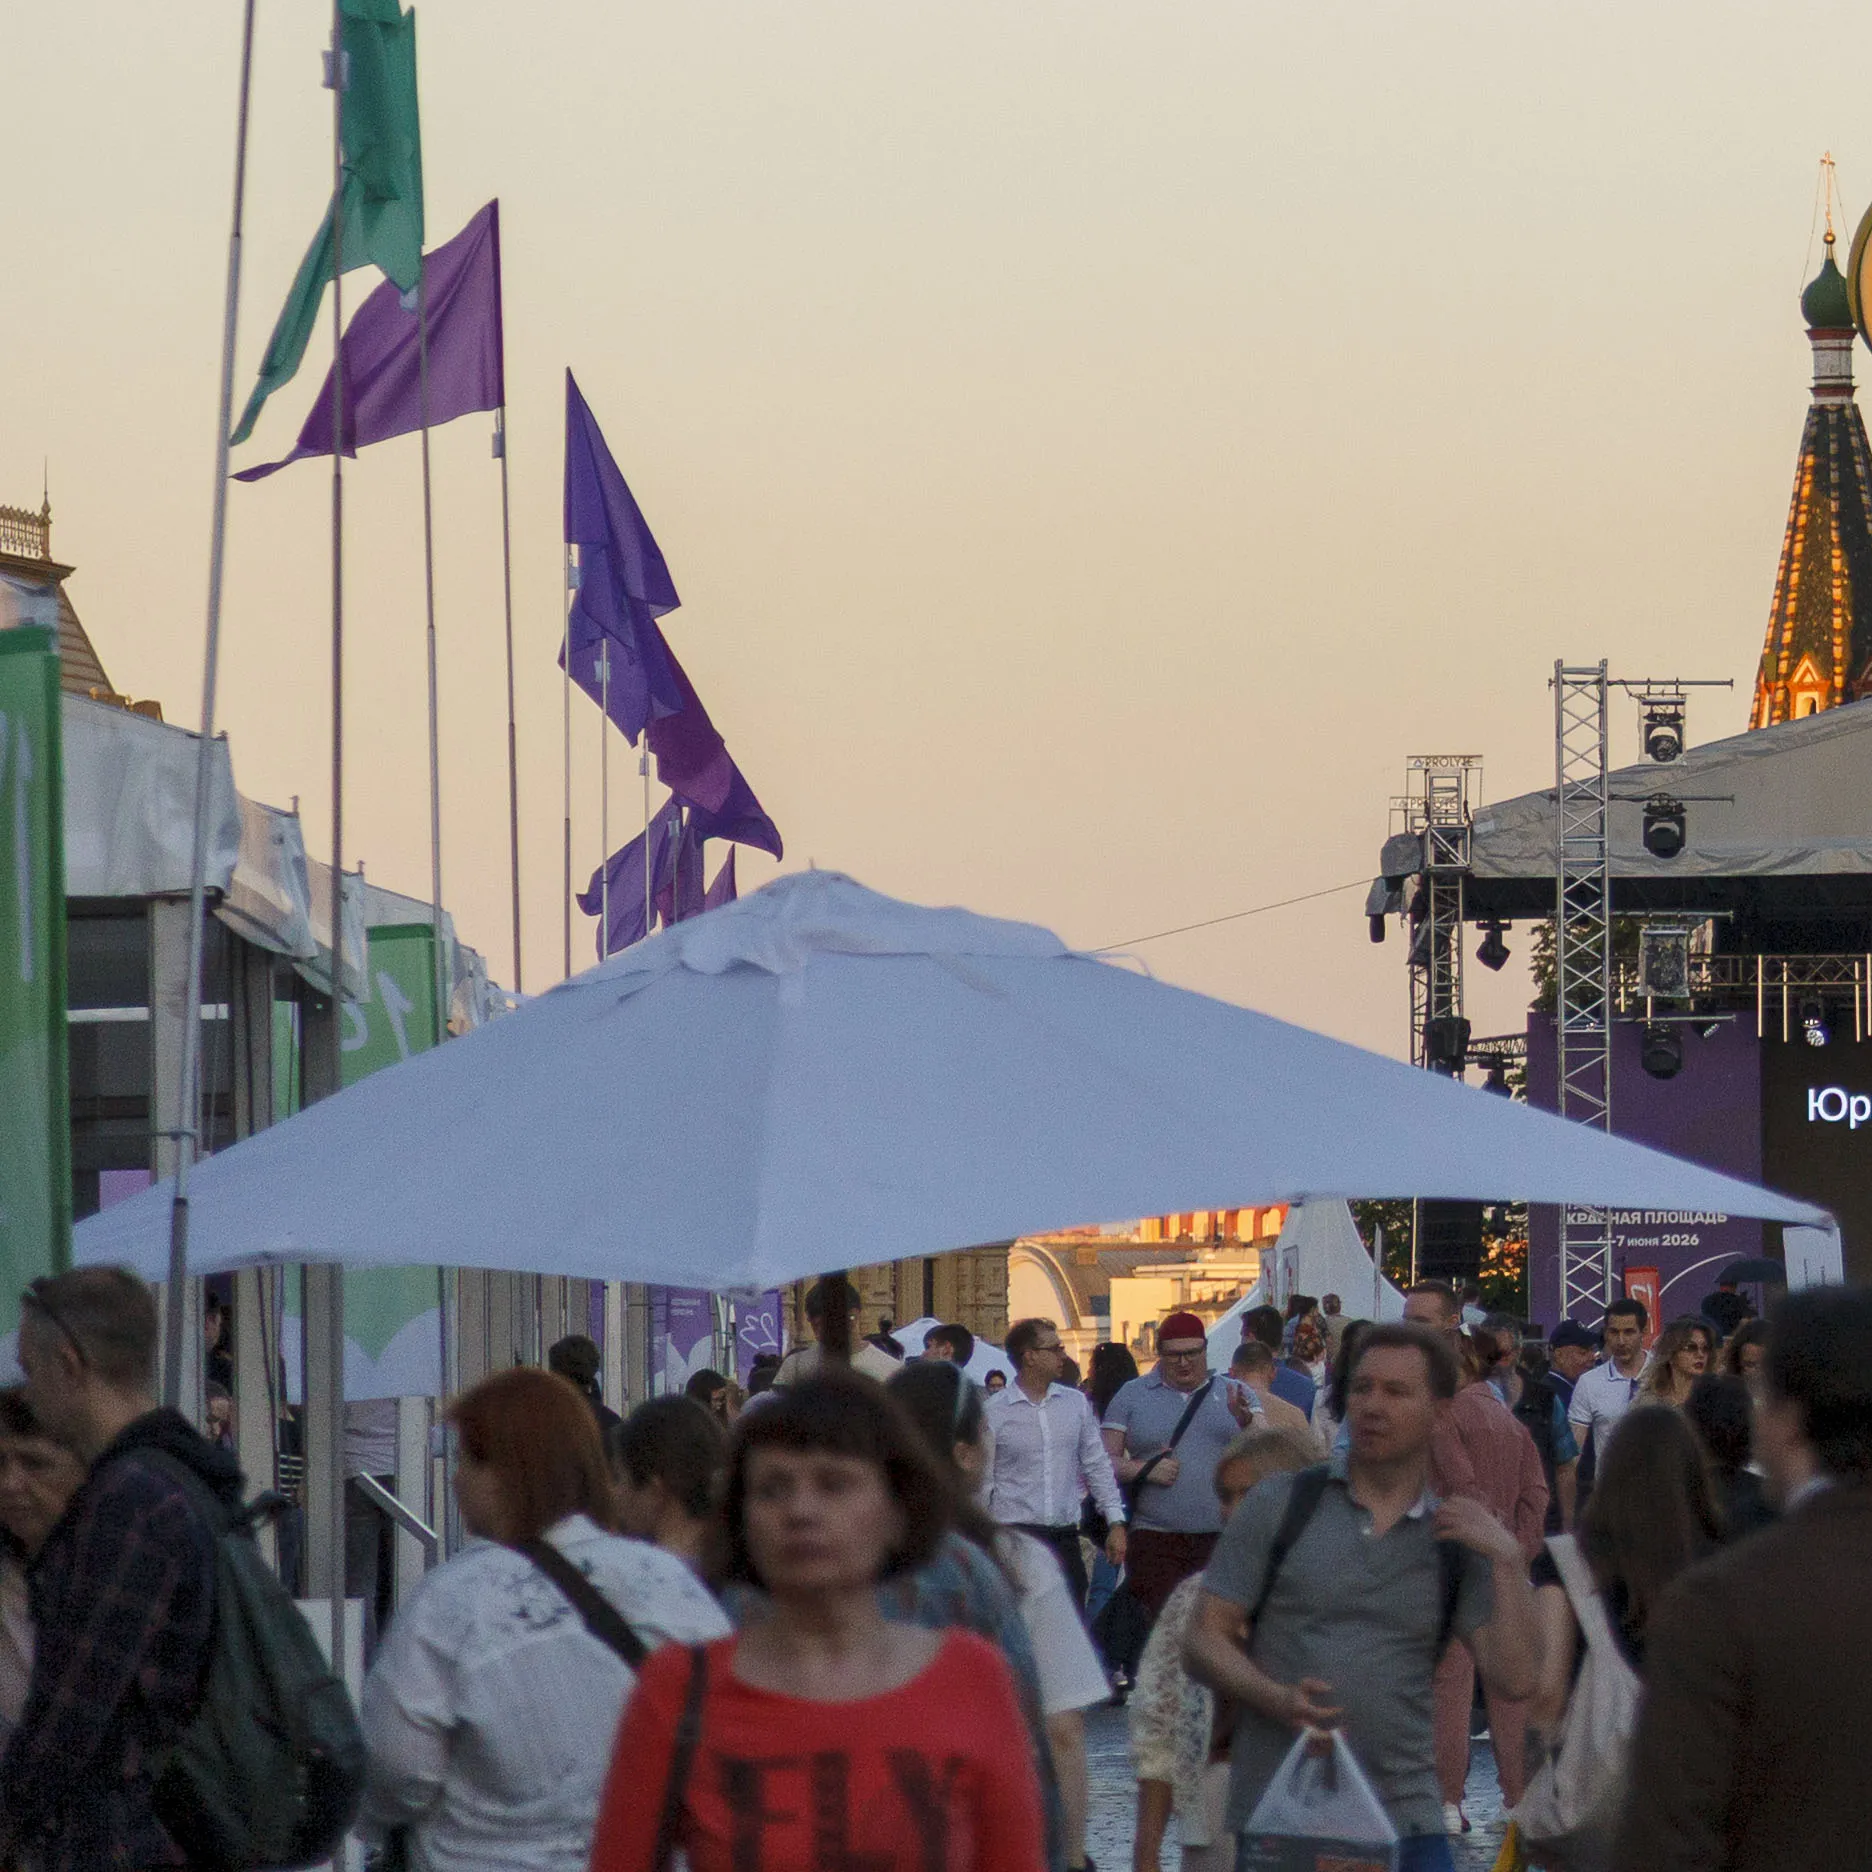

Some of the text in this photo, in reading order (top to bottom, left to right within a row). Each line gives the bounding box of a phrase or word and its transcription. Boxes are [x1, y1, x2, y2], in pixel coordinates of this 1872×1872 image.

[1425, 757, 1473, 767] PROLYTE
[1644, 1210, 1728, 1226] ПЛОЩАДЬ
[1627, 1236, 1660, 1247] июня
[1661, 1233, 1700, 1247] 2026
[713, 1746, 968, 1872] FLY
